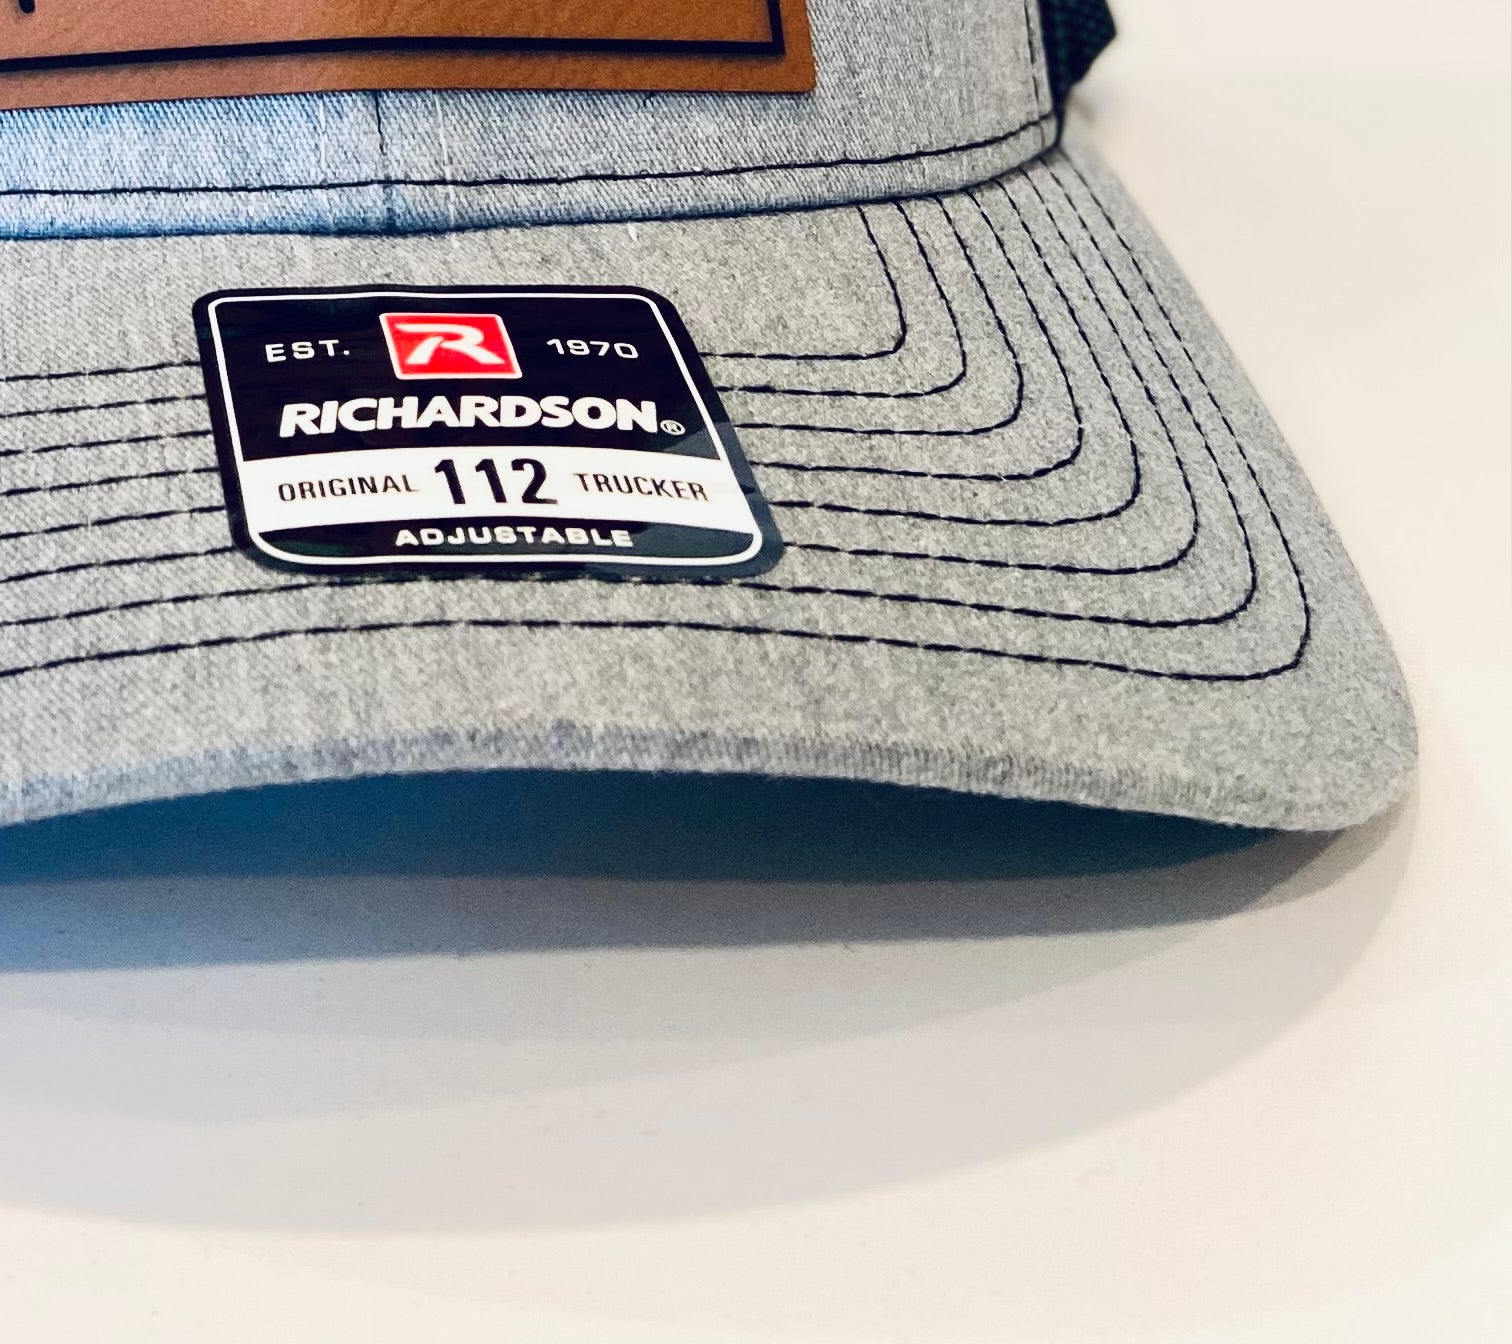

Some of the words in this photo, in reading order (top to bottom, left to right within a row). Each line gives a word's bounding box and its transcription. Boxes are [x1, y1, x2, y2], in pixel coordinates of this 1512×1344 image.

[265, 338, 350, 364] EST.
[546, 337, 639, 360] 1970
[277, 473, 419, 502] ORIGINAL
[434, 457, 559, 506] 112
[574, 472, 710, 503] TRUCKER
[394, 525, 634, 548] ADJUSTABLE
